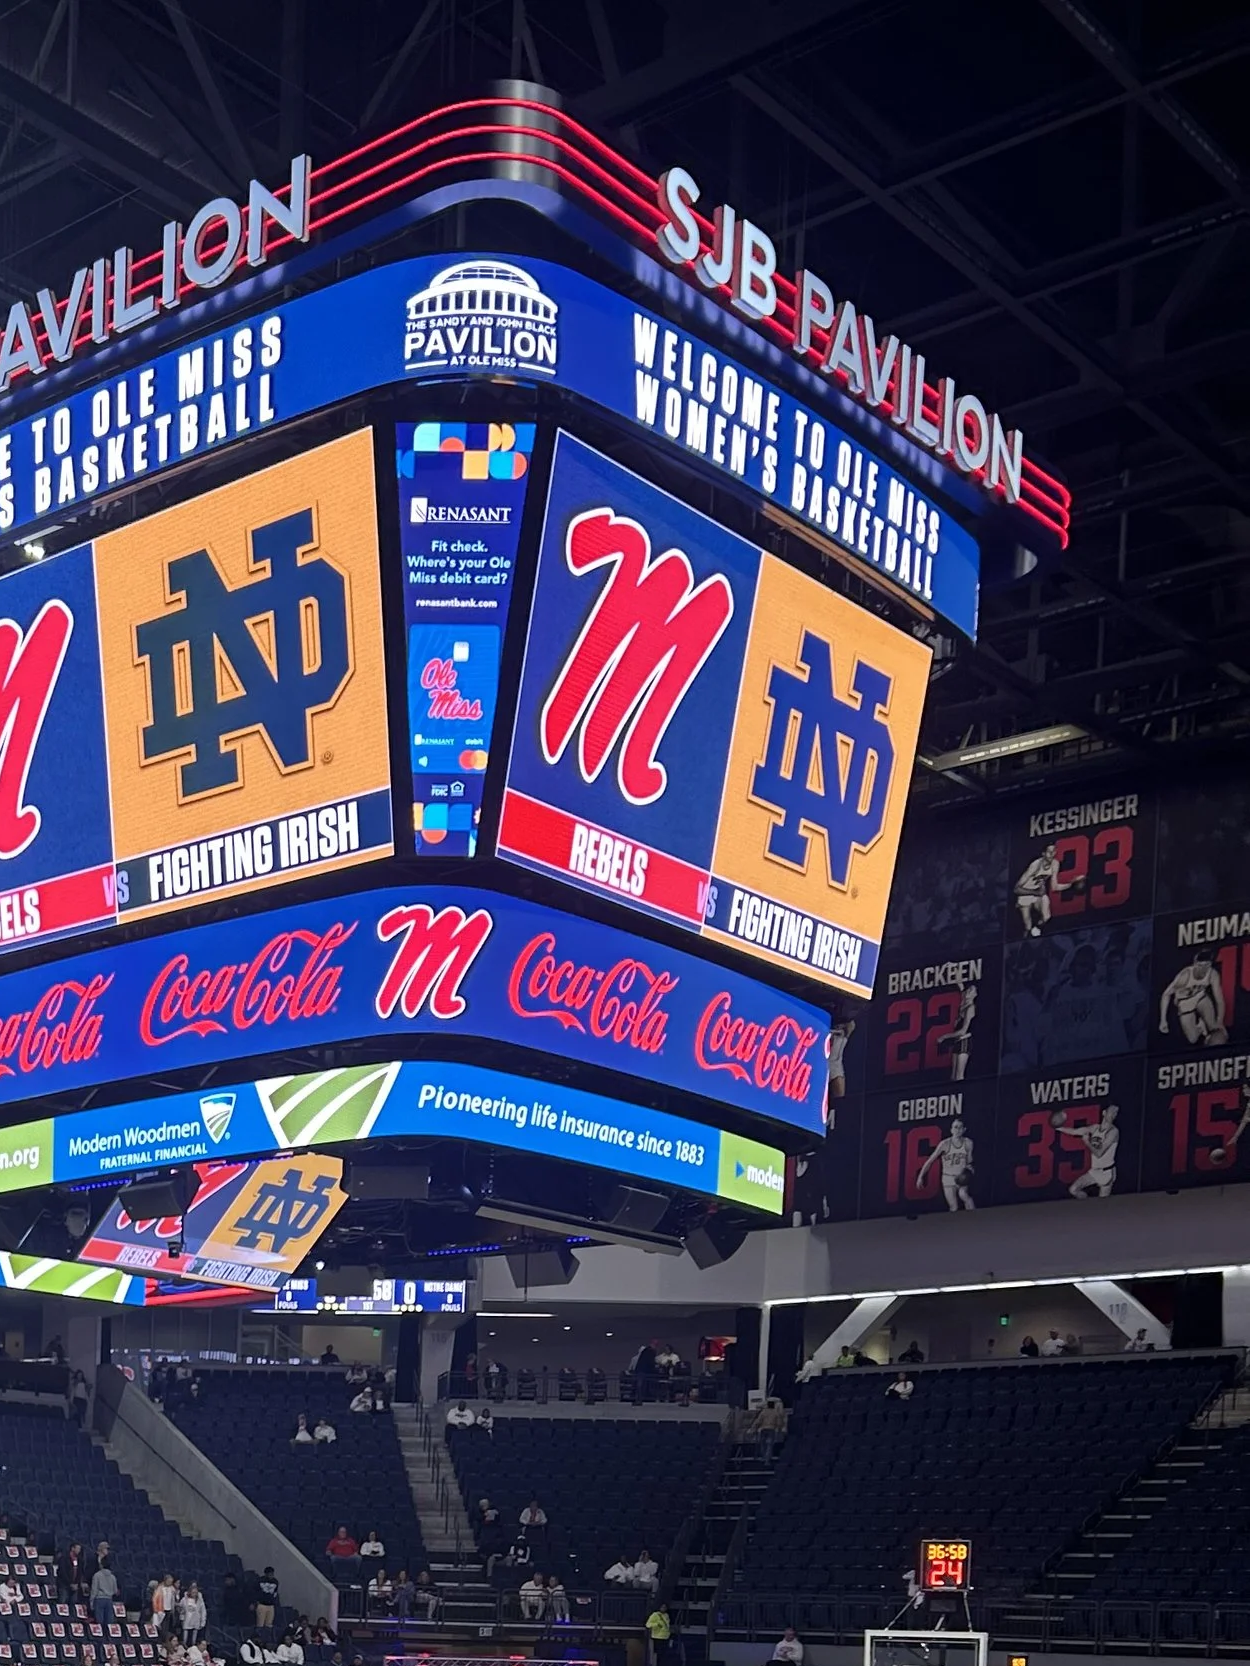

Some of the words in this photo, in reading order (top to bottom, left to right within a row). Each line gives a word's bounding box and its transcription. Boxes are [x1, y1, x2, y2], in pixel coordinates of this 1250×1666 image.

[406, 321, 427, 332] THE
[430, 316, 467, 328] SANDY
[470, 316, 493, 326] AND
[496, 318, 523, 328] JOHN
[525, 322, 556, 336] BLACK
[655, 166, 777, 321] SJB
[793, 269, 1023, 504] PAVILION
[405, 327, 557, 364] PAVILION
[450, 356, 466, 365] AT
[468, 356, 490, 366] OLE
[492, 357, 516, 367] MISS
[31, 407, 71, 462] TO
[93, 369, 154, 432] OLE
[178, 316, 282, 399] MISS
[35, 381, 274, 512] BASKETBALL
[633, 312, 781, 441] WELCOME
[794, 409, 825, 466] TO
[837, 437, 877, 506] OLE
[887, 476, 940, 551] MISS
[634, 367, 778, 495] WOMEN'S
[792, 470, 934, 600] BASKETBALL
[427, 507, 511, 521] RENASANT
[431, 540, 448, 552] Fit
[450, 540, 488, 552] check.
[407, 555, 456, 568] Where's
[459, 559, 486, 570] your
[490, 557, 511, 568] Ole
[409, 572, 436, 583] Miss
[440, 572, 471, 584] debit
[474, 573, 508, 584] card?
[415, 597, 498, 608] renasantbank.com
[420, 657, 457, 689] Ole
[428, 689, 483, 720] Miss
[1029, 794, 1139, 838] KESSINGER
[103, 870, 129, 907] VS
[150, 826, 273, 902] FIGHTING
[279, 801, 359, 865] IRISH
[1051, 824, 1134, 916] 23
[569, 822, 648, 897] REBELS
[696, 879, 718, 918] VS
[728, 888, 816, 962] FIGHTING
[812, 923, 862, 981] IRISH
[888, 958, 982, 995] BRACKEEN
[1031, 1073, 1110, 1104] WATERS
[898, 1093, 963, 1121] GIBBON
[69, 1128, 121, 1157] Modern
[124, 1120, 201, 1148] Woodmen
[418, 1084, 528, 1128] Pioneering
[530, 1103, 558, 1131] life
[560, 1110, 635, 1148] insurance
[636, 1126, 673, 1157] since
[675, 1139, 706, 1166] 1883
[99, 1151, 152, 1170] FRATERNAL
[155, 1143, 208, 1161] FINANCIAL
[118, 1246, 161, 1267] REBELS
[200, 1260, 248, 1282] FIGHTING
[249, 1268, 282, 1287] IRISH
[278, 1301, 298, 1309] FOULS
[373, 1279, 392, 1301] 58
[403, 1282, 416, 1305] 0
[928, 1544, 967, 1560] 36:58
[930, 1560, 963, 1585] 24
